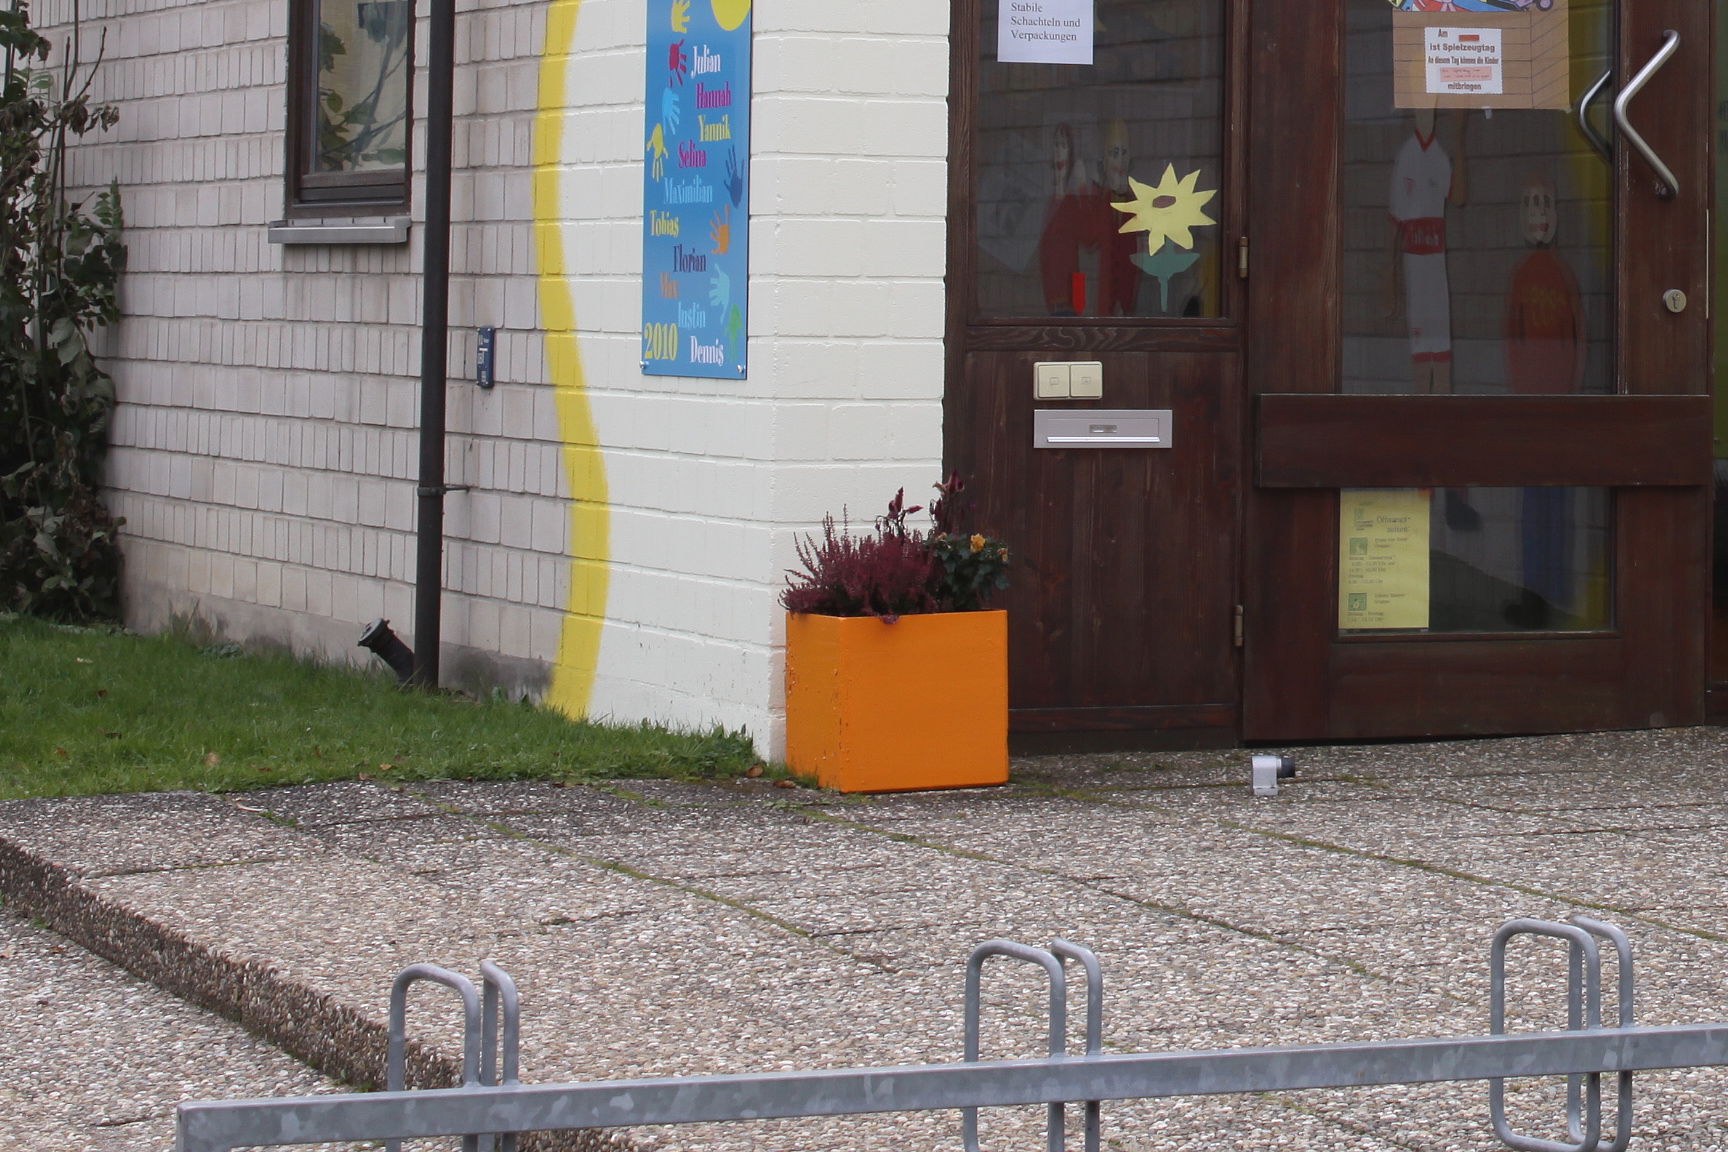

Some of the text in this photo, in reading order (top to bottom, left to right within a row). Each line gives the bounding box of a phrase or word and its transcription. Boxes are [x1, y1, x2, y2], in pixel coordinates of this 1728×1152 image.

[1010, 1, 1043, 13] Stabile
[1010, 16, 1081, 28] Schachteln und
[1010, 30, 1077, 43] Verpackungen
[690, 44, 721, 79] Julian
[696, 80, 732, 109] Hannah
[677, 138, 708, 169] Selina
[663, 174, 713, 205] Maximilian
[649, 209, 680, 239] Tobias
[672, 243, 707, 273] Florian
[643, 322, 679, 361] 2010
[690, 335, 725, 367] Dennis
